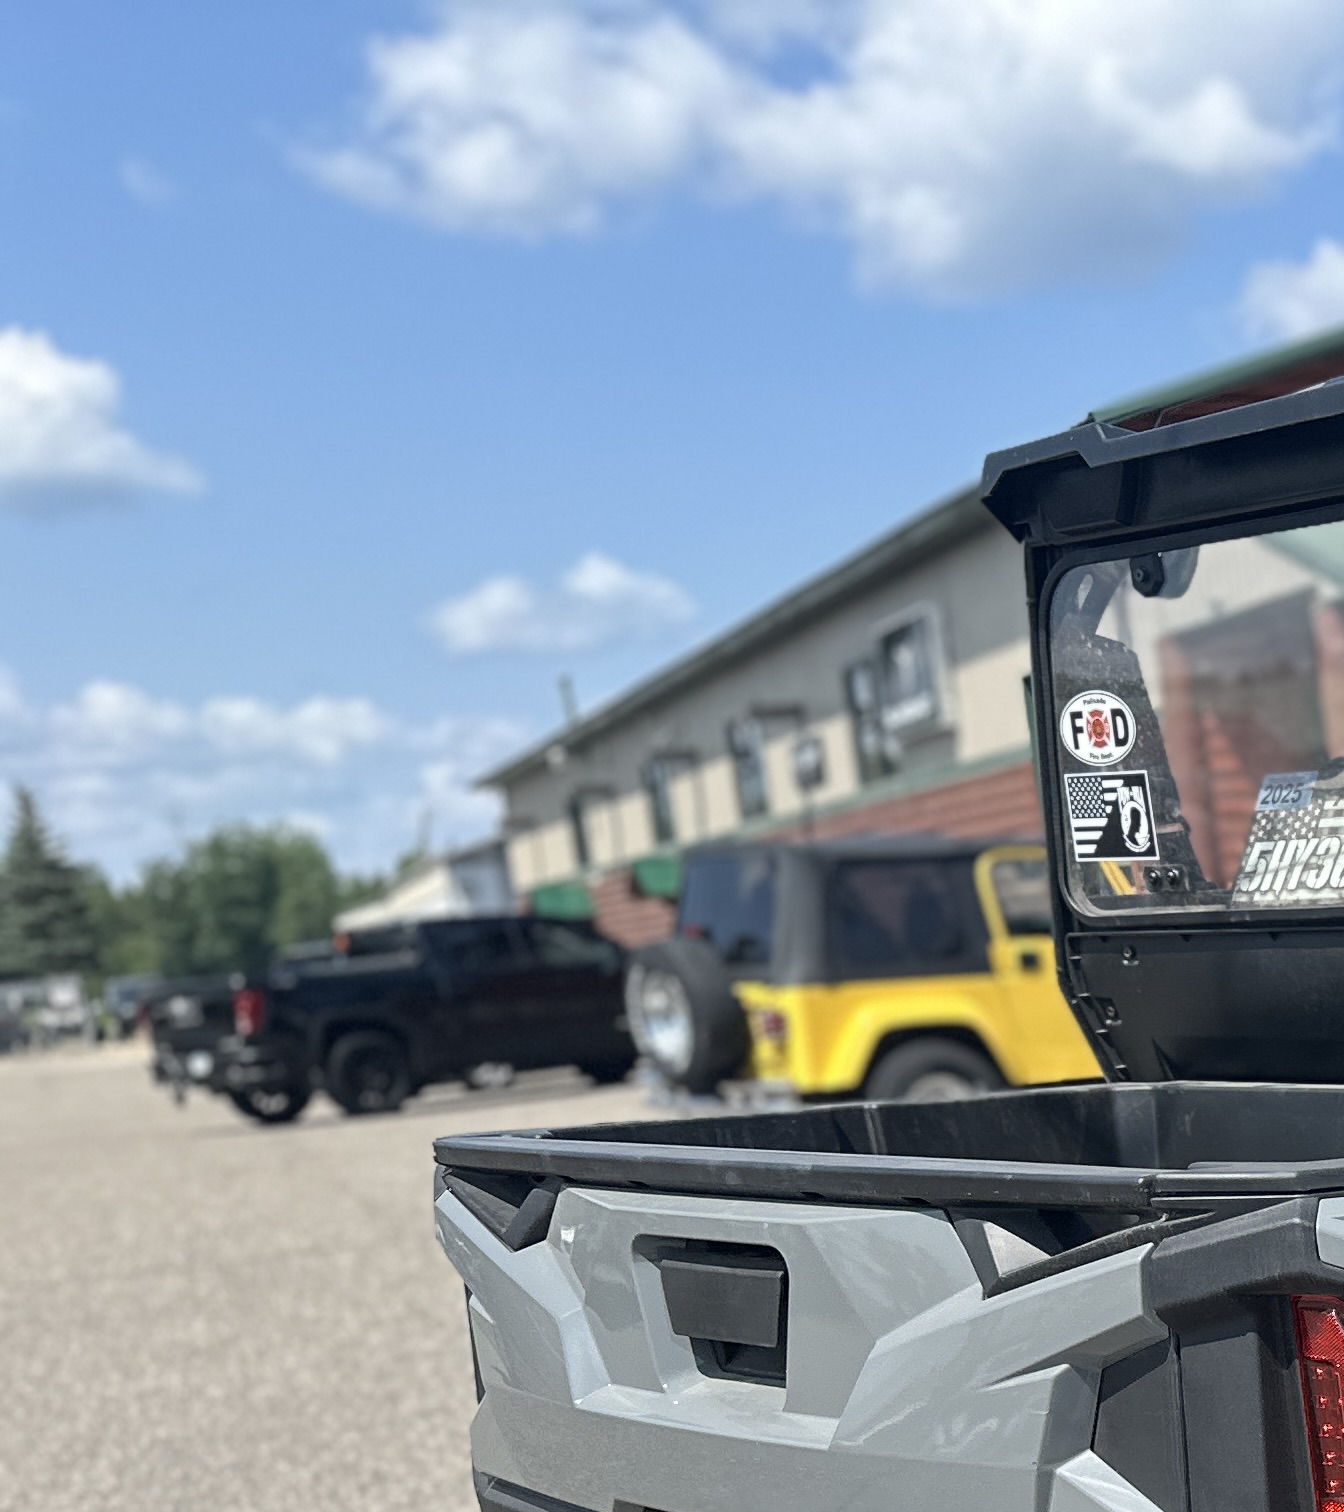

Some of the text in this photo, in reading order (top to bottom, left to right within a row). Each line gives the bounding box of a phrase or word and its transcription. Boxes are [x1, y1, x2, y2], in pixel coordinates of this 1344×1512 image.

[1069, 708, 1130, 750] F D
[1260, 782, 1304, 805] 2025
